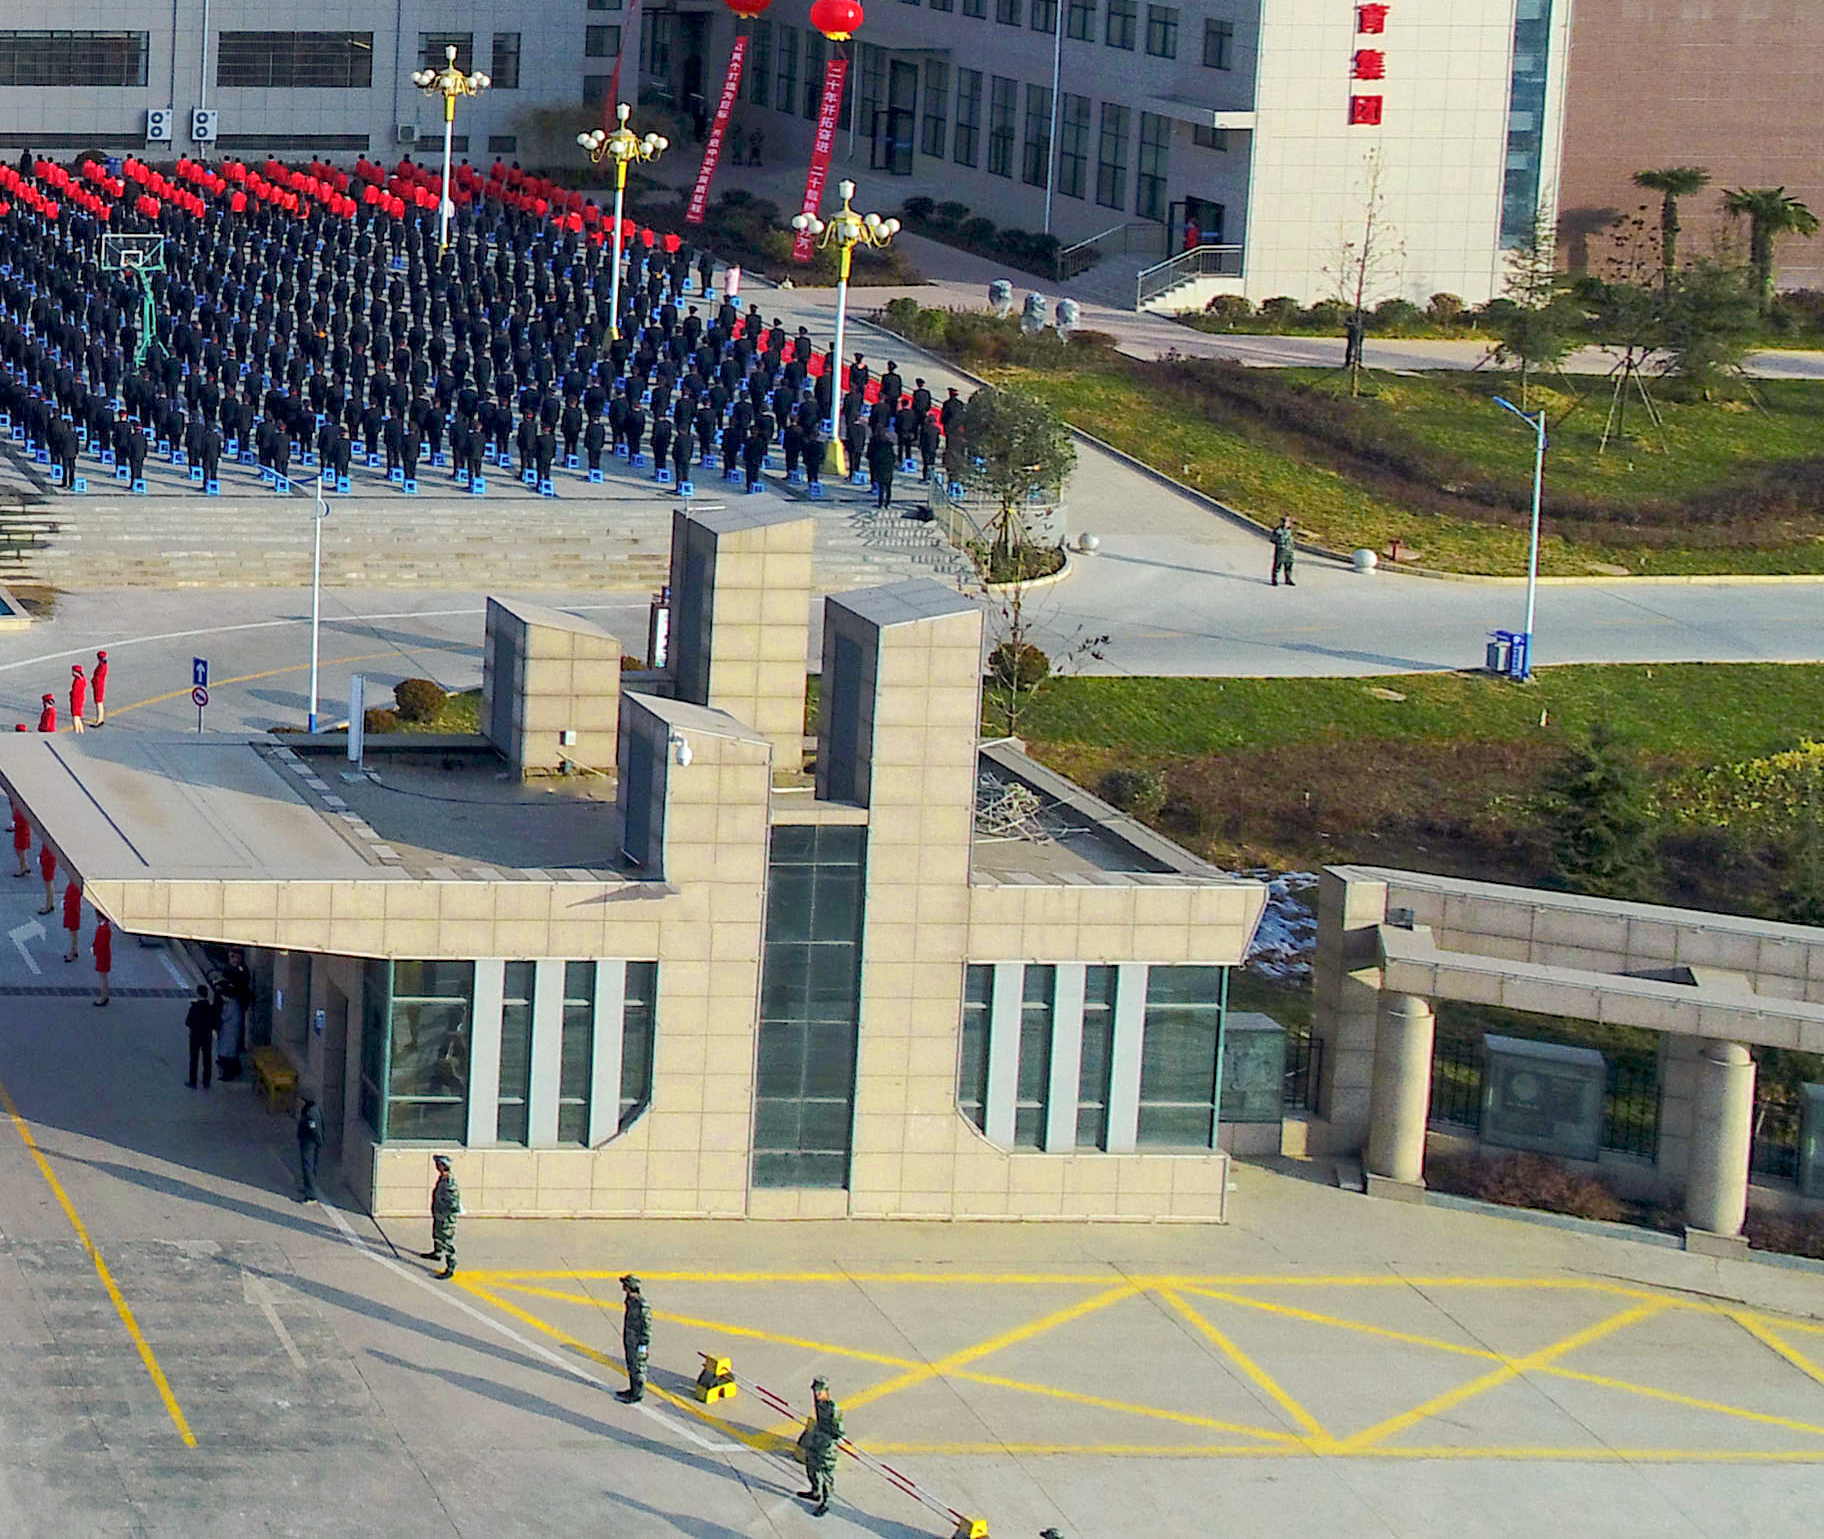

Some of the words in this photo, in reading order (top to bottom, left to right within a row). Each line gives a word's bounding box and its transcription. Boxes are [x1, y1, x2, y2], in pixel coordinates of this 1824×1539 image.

[815, 66, 842, 154] 二十年开拓奋进
